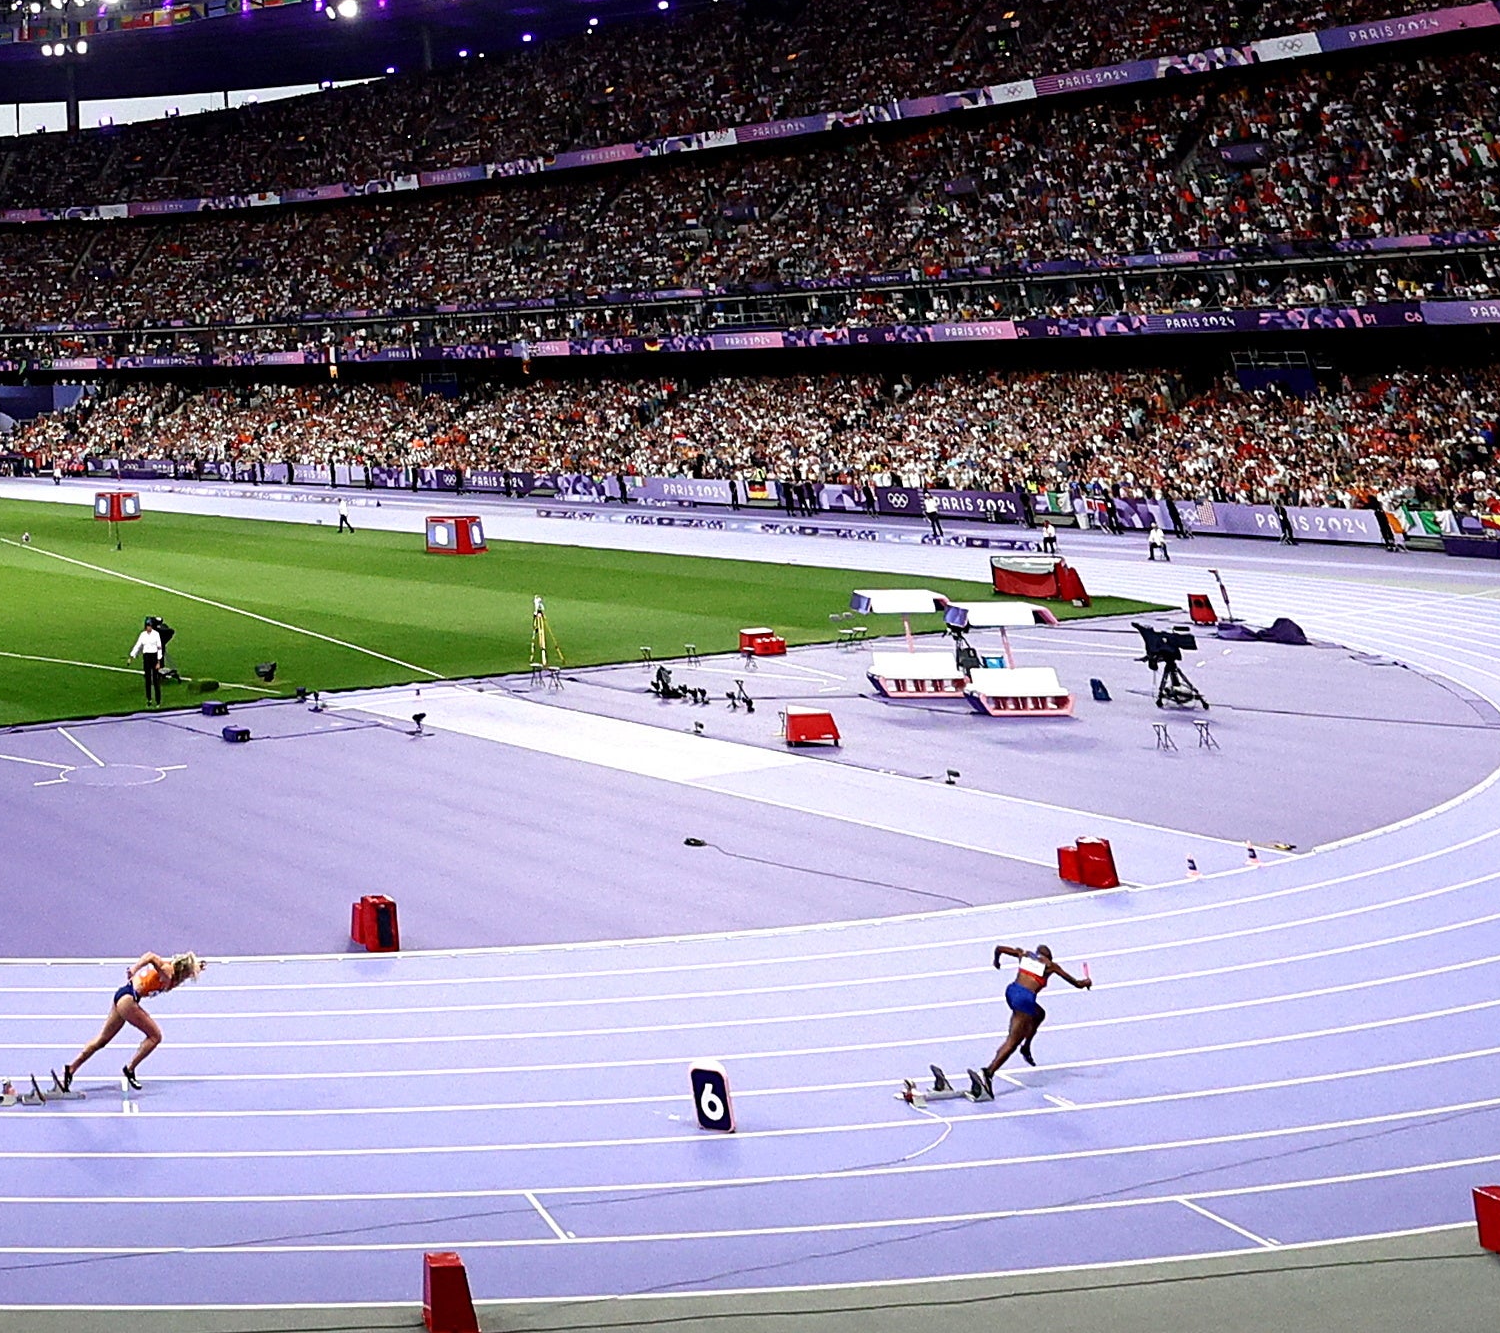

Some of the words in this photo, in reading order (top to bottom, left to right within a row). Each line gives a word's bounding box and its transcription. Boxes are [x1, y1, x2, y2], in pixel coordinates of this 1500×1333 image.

[1349, 26, 1393, 42] PARIS
[1397, 19, 1440, 35] 2024
[1059, 73, 1093, 89] PARIS
[1095, 69, 1129, 84] 2024
[1166, 318, 1200, 329] PARIS
[1201, 315, 1236, 327] 2024
[471, 477, 498, 487] PARIS
[663, 483, 693, 494] PARIS
[697, 484, 727, 497] 2024
[976, 498, 1016, 513] 2024
[1255, 513, 1310, 531] PAIS
[1314, 516, 1368, 534] 2024
[700, 1083, 724, 1121] 6
